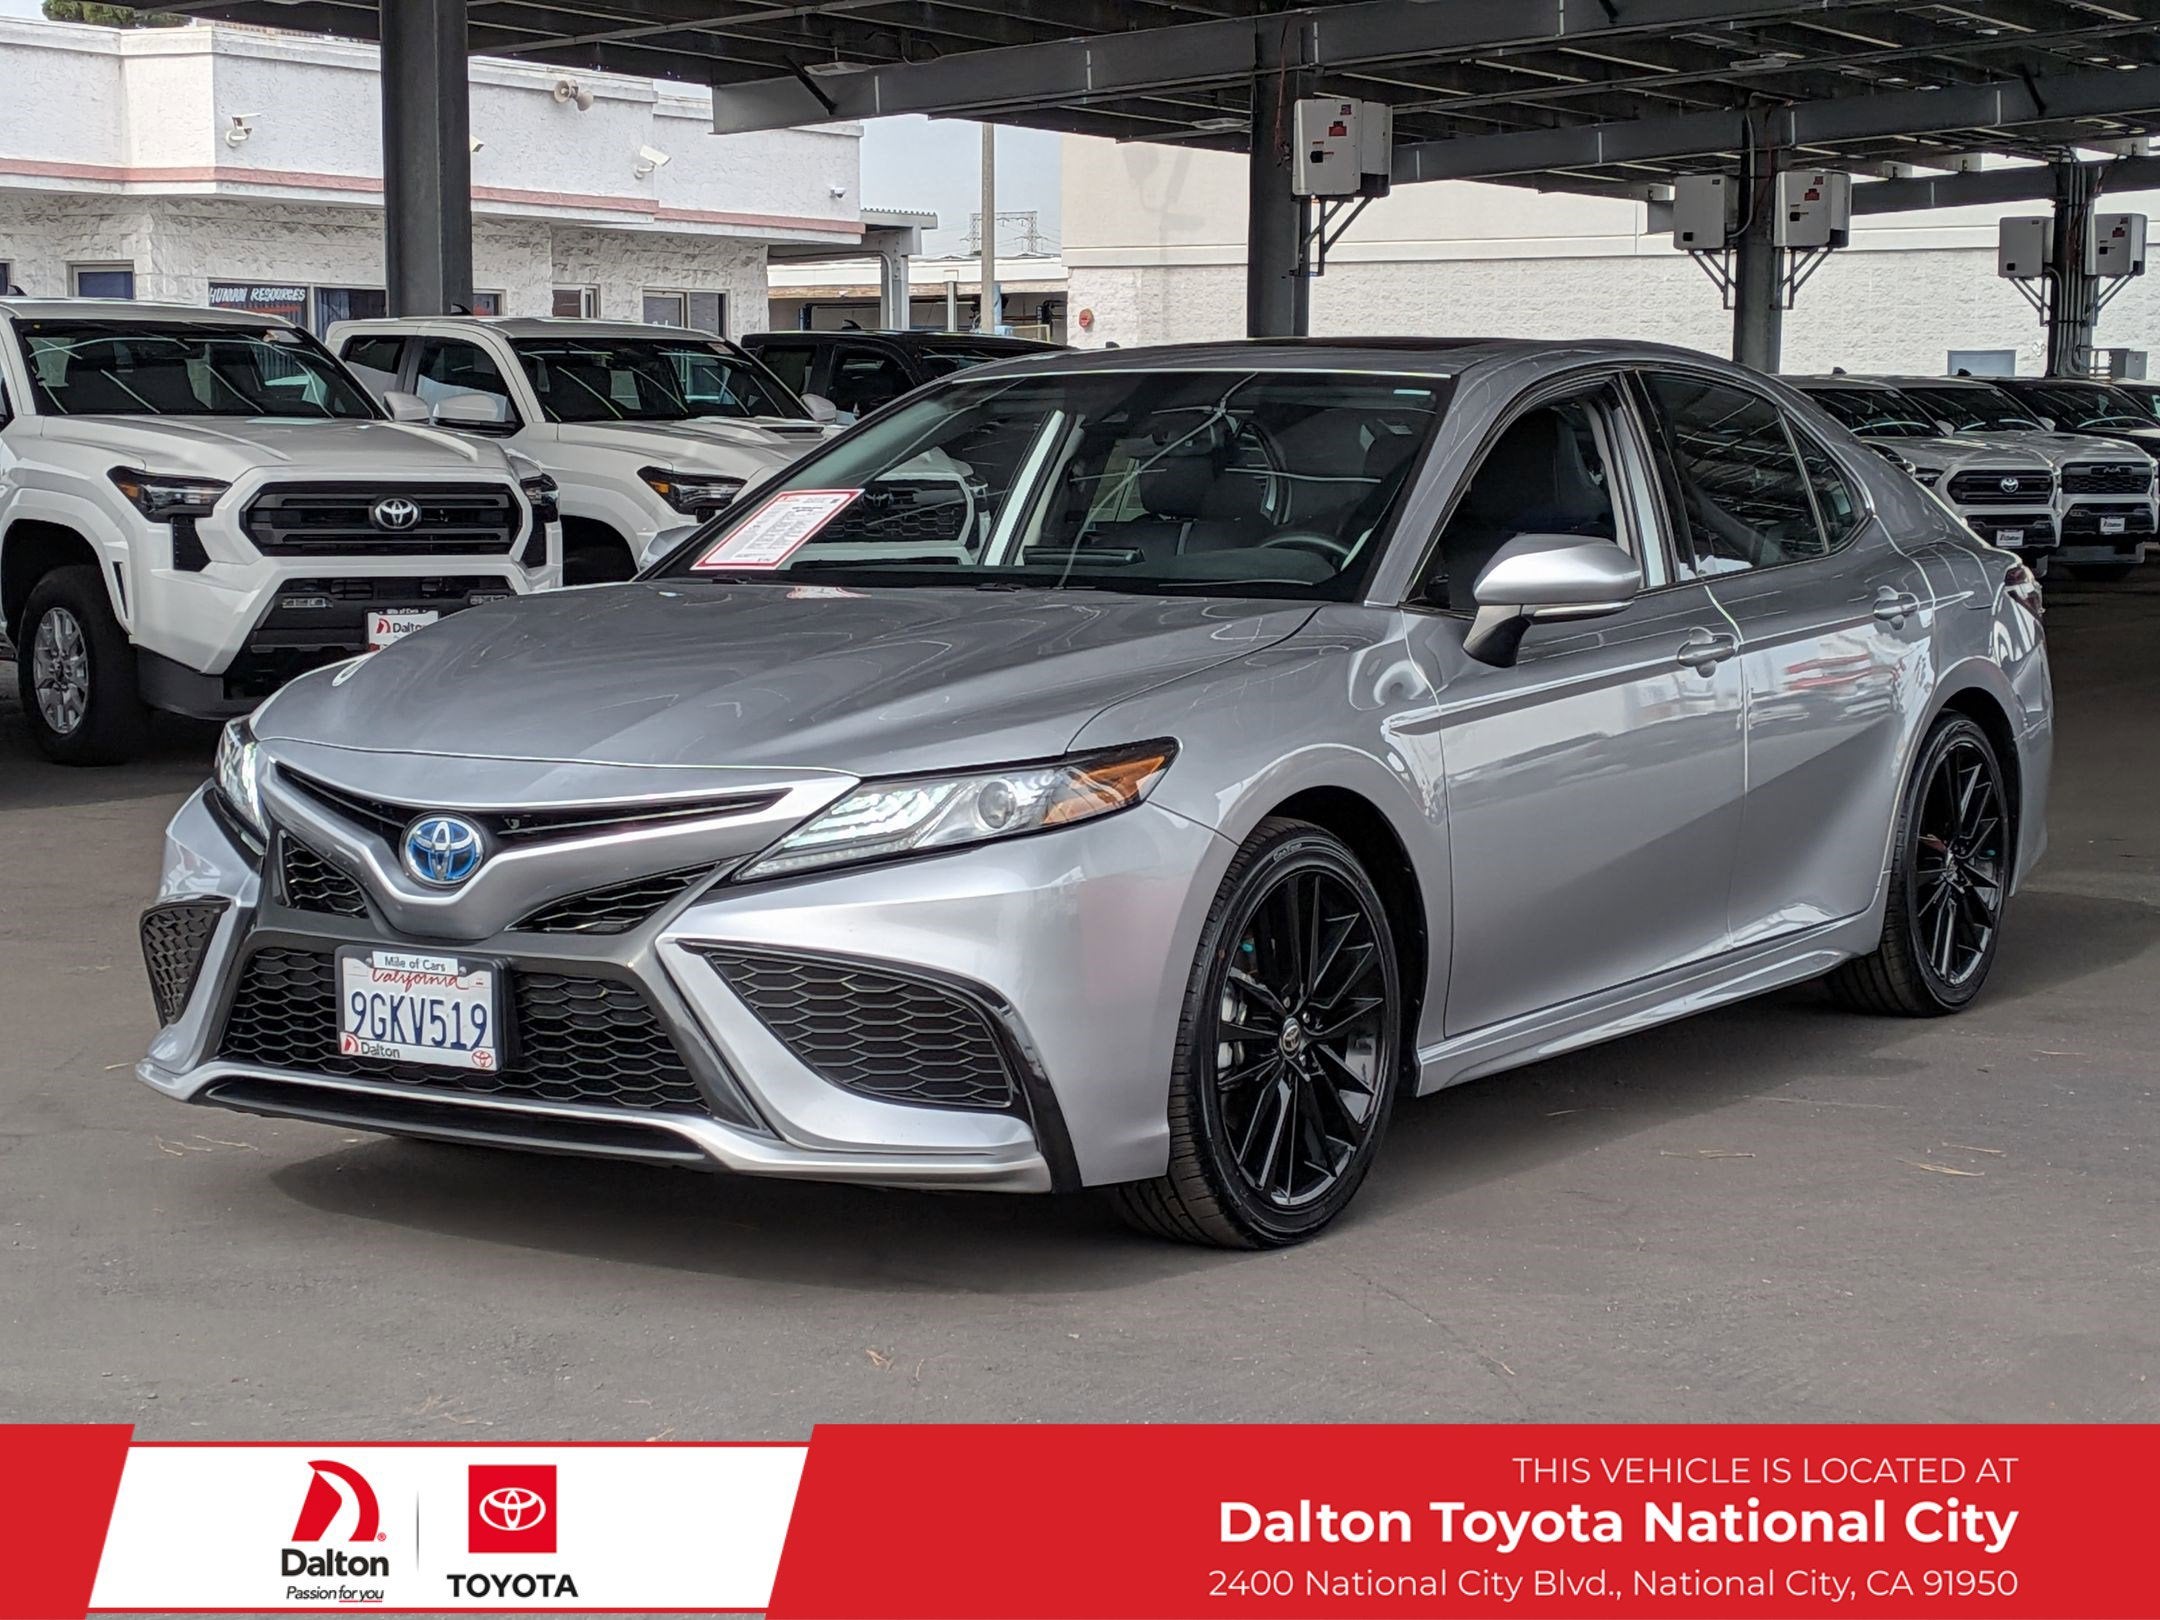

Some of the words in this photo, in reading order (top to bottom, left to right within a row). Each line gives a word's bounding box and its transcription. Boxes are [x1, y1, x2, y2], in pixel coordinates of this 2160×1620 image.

[209, 287, 247, 303] HUMAN
[250, 287, 306, 303] RESOURCES
[393, 621, 424, 633] Dalto
[384, 956, 406, 967] Mile
[409, 958, 420, 969] of
[422, 959, 446, 972] Cars
[371, 968, 469, 993] California
[351, 990, 488, 1051] 9GKV519
[361, 1041, 401, 1059] Dalton
